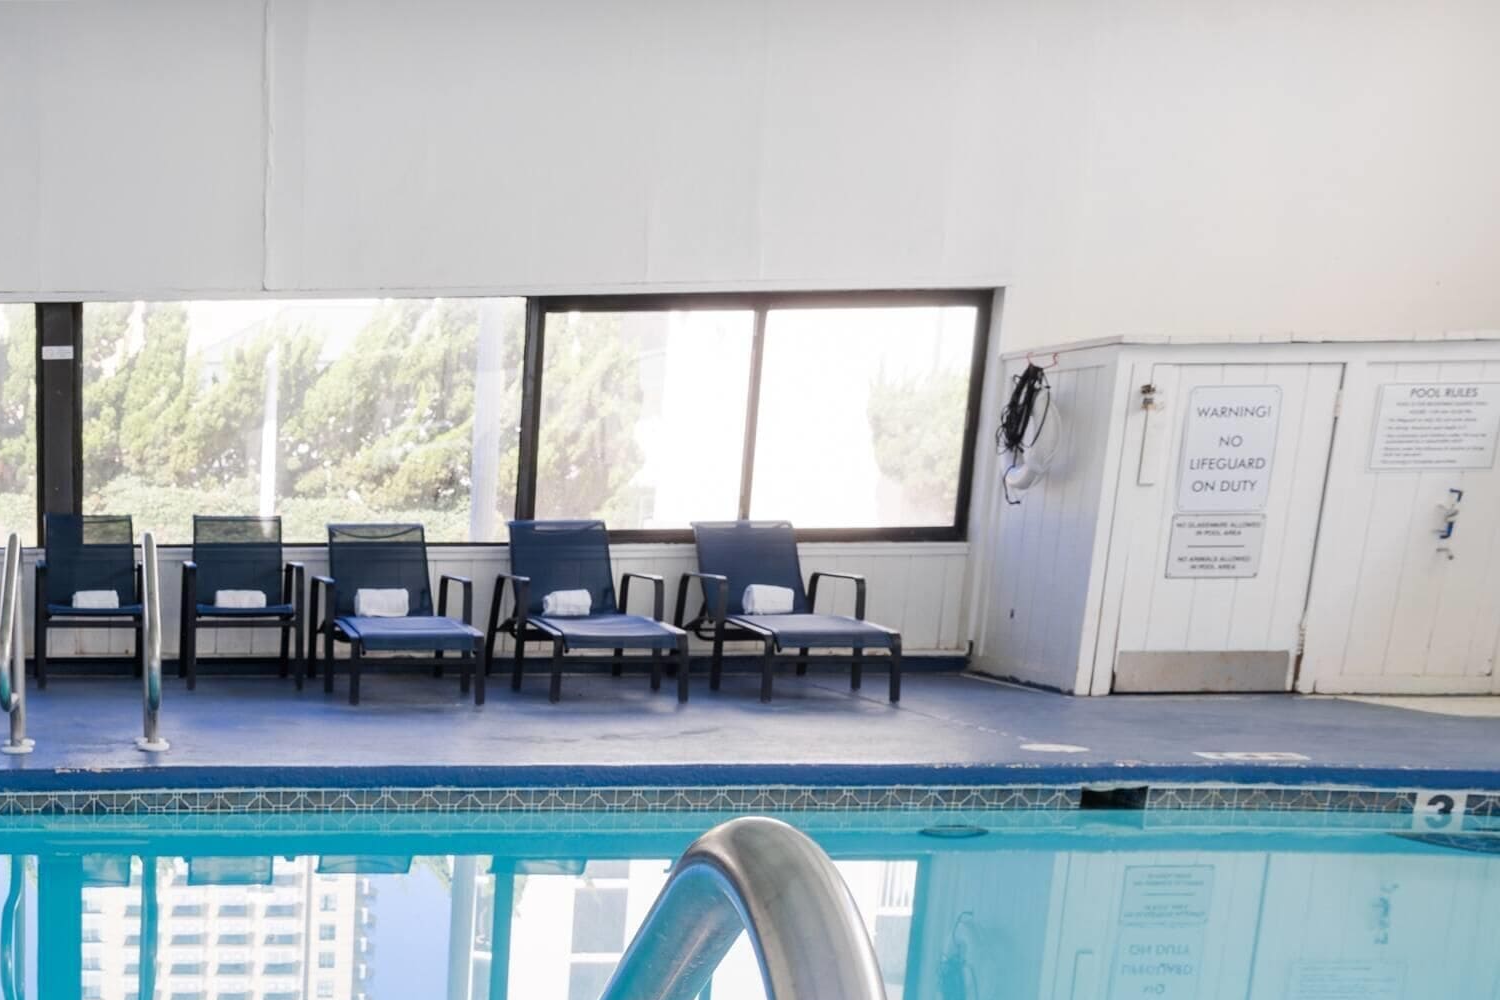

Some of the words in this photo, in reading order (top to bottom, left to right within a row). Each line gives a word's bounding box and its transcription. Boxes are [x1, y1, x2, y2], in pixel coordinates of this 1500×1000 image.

[1411, 387, 1441, 399] POOL
[1444, 386, 1479, 398] RULES
[1196, 405, 1272, 418] WARNING!
[1218, 434, 1244, 448] NO
[1188, 456, 1267, 470] LIFEGUARD
[1191, 479, 1217, 493] ON
[1219, 479, 1258, 492] DUTY
[1425, 794, 1455, 828] 3
